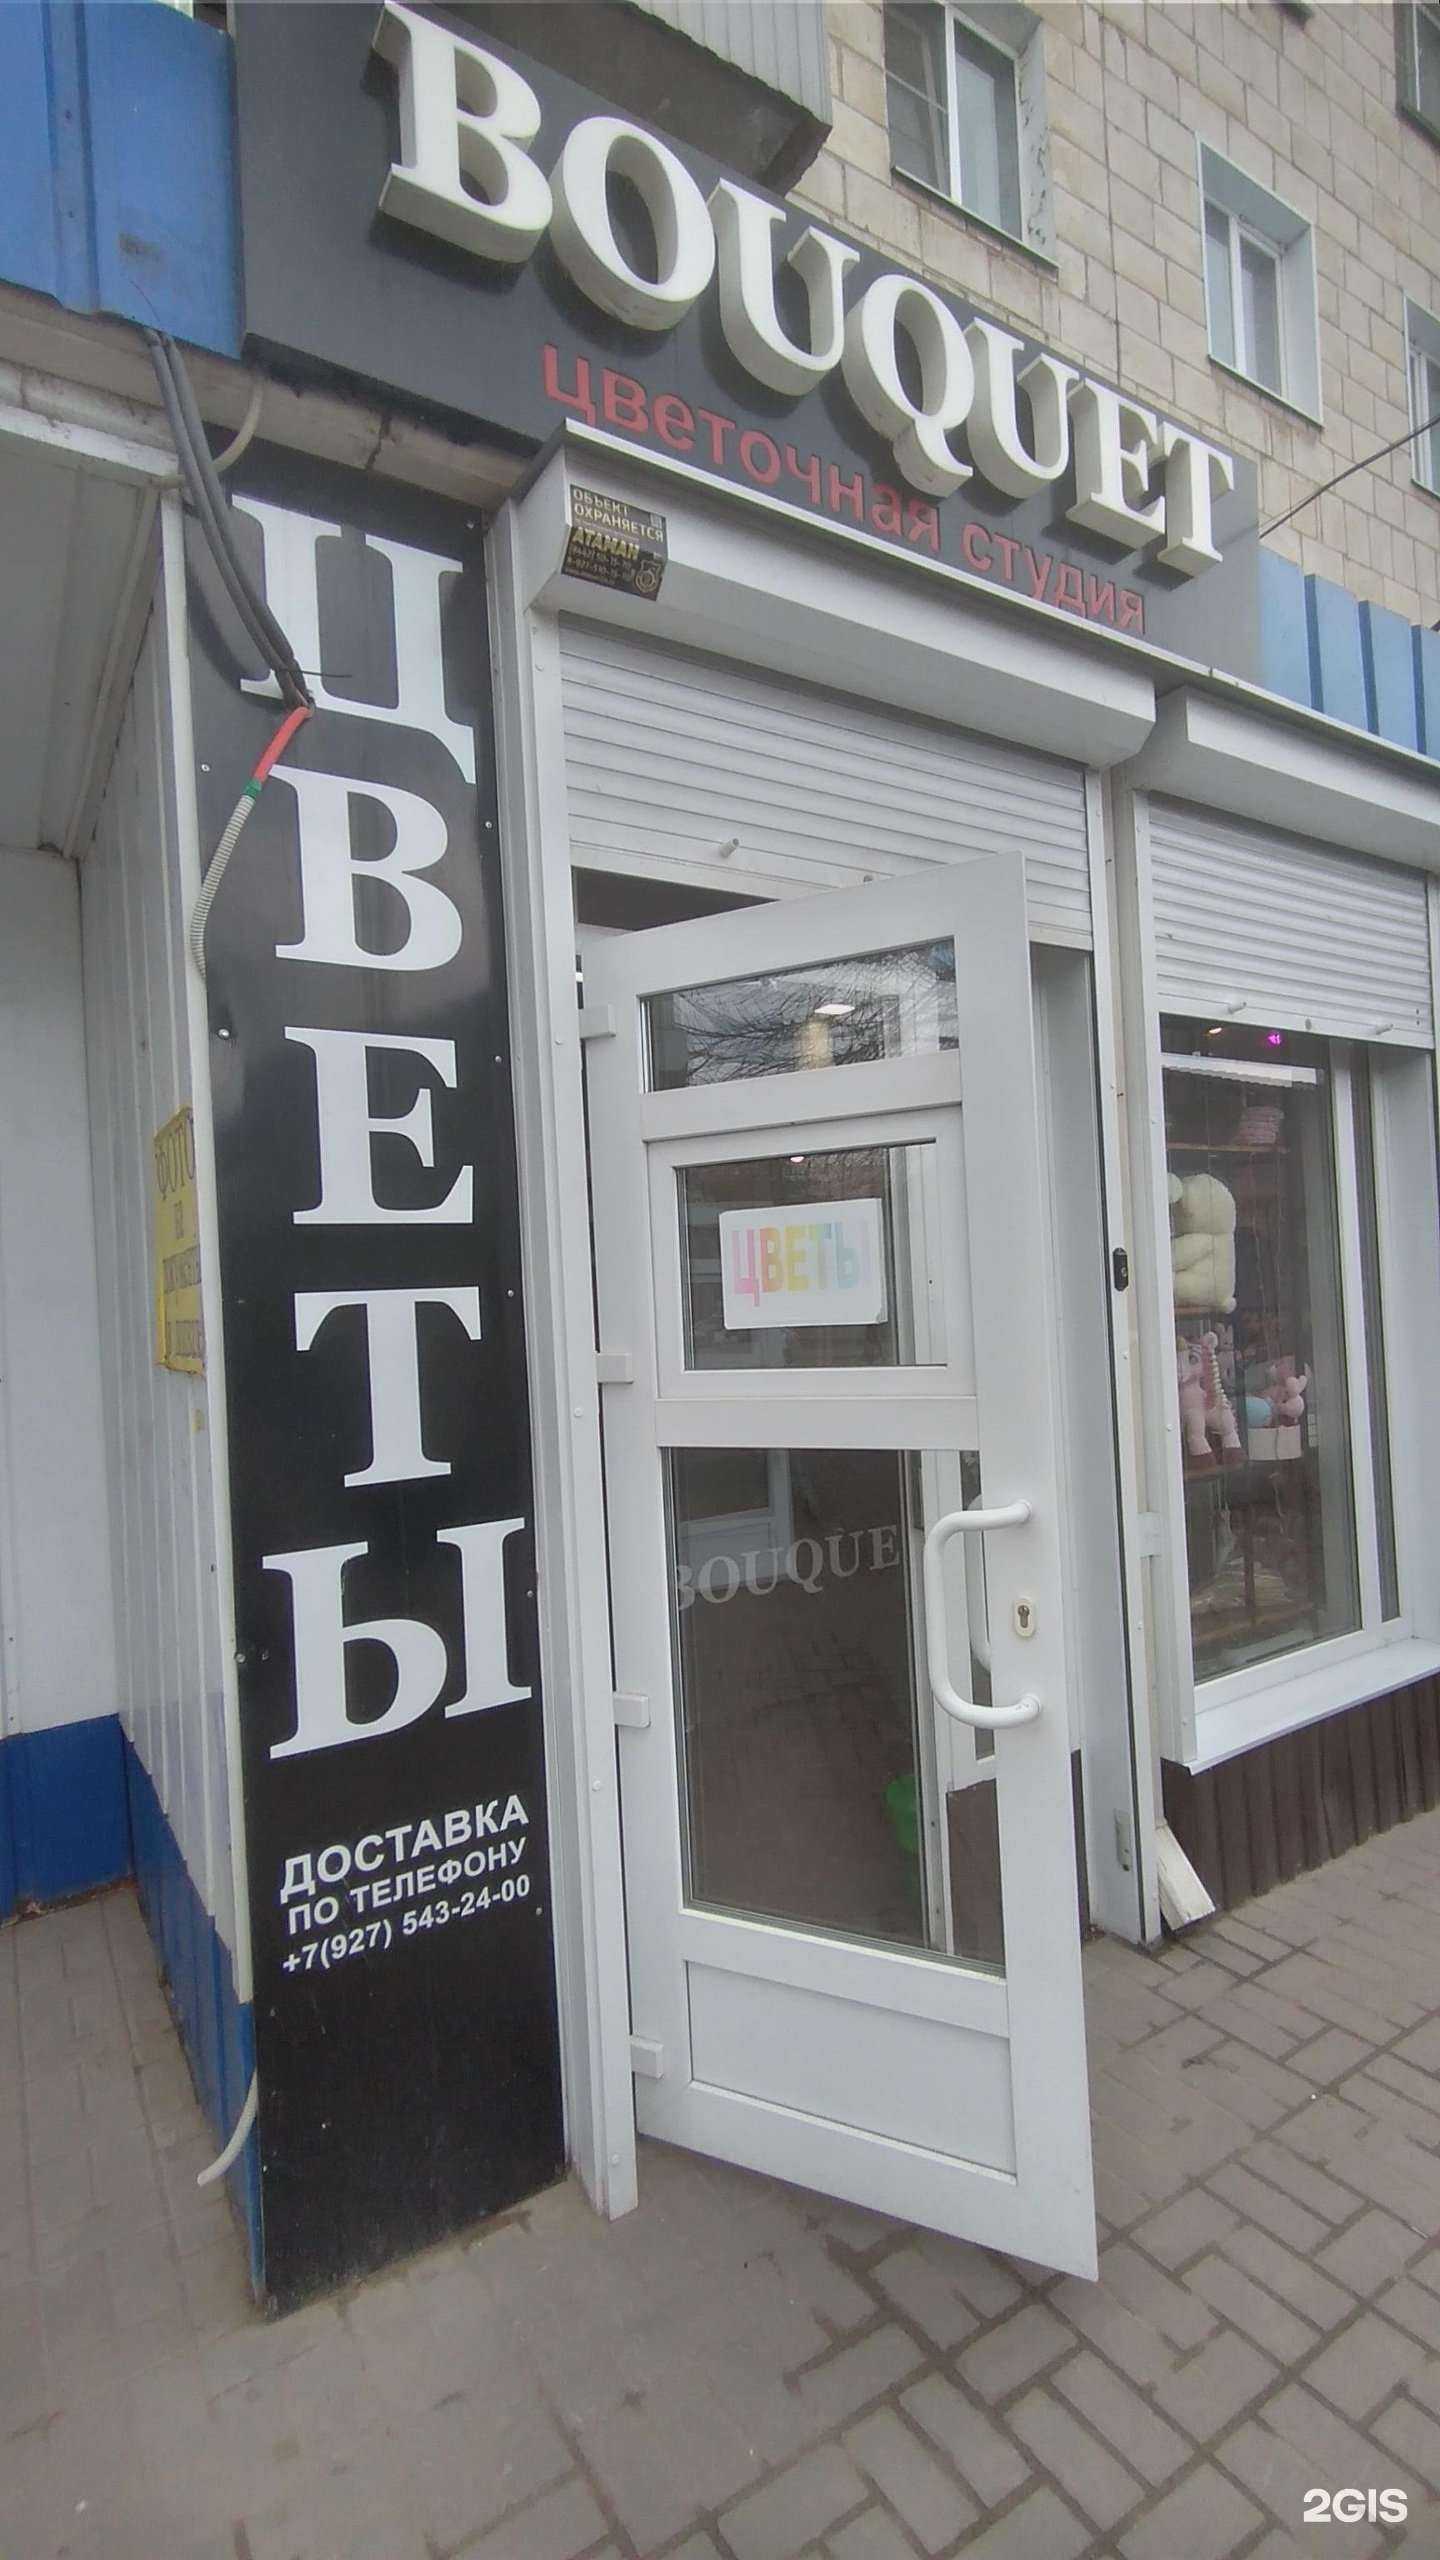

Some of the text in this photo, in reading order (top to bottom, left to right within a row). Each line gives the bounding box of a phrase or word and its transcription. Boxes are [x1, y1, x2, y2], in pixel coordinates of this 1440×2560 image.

[374, 1, 1235, 579] BOUQUET
[573, 488, 630, 517] ОБЪЕКТ
[573, 526, 640, 560] АТАМАН
[574, 503, 664, 543] ОХРАНЯЕТСЯ
[961, 522, 1146, 635] студия
[232, 495, 532, 1760] ЦВЕТЫ
[279, 1794, 530, 1904] ДОСТАВКА
[288, 1837, 527, 1935] ПО ТЕЛЕФОНУ
[282, 1874, 531, 1972] +7(927) 543-24-00
